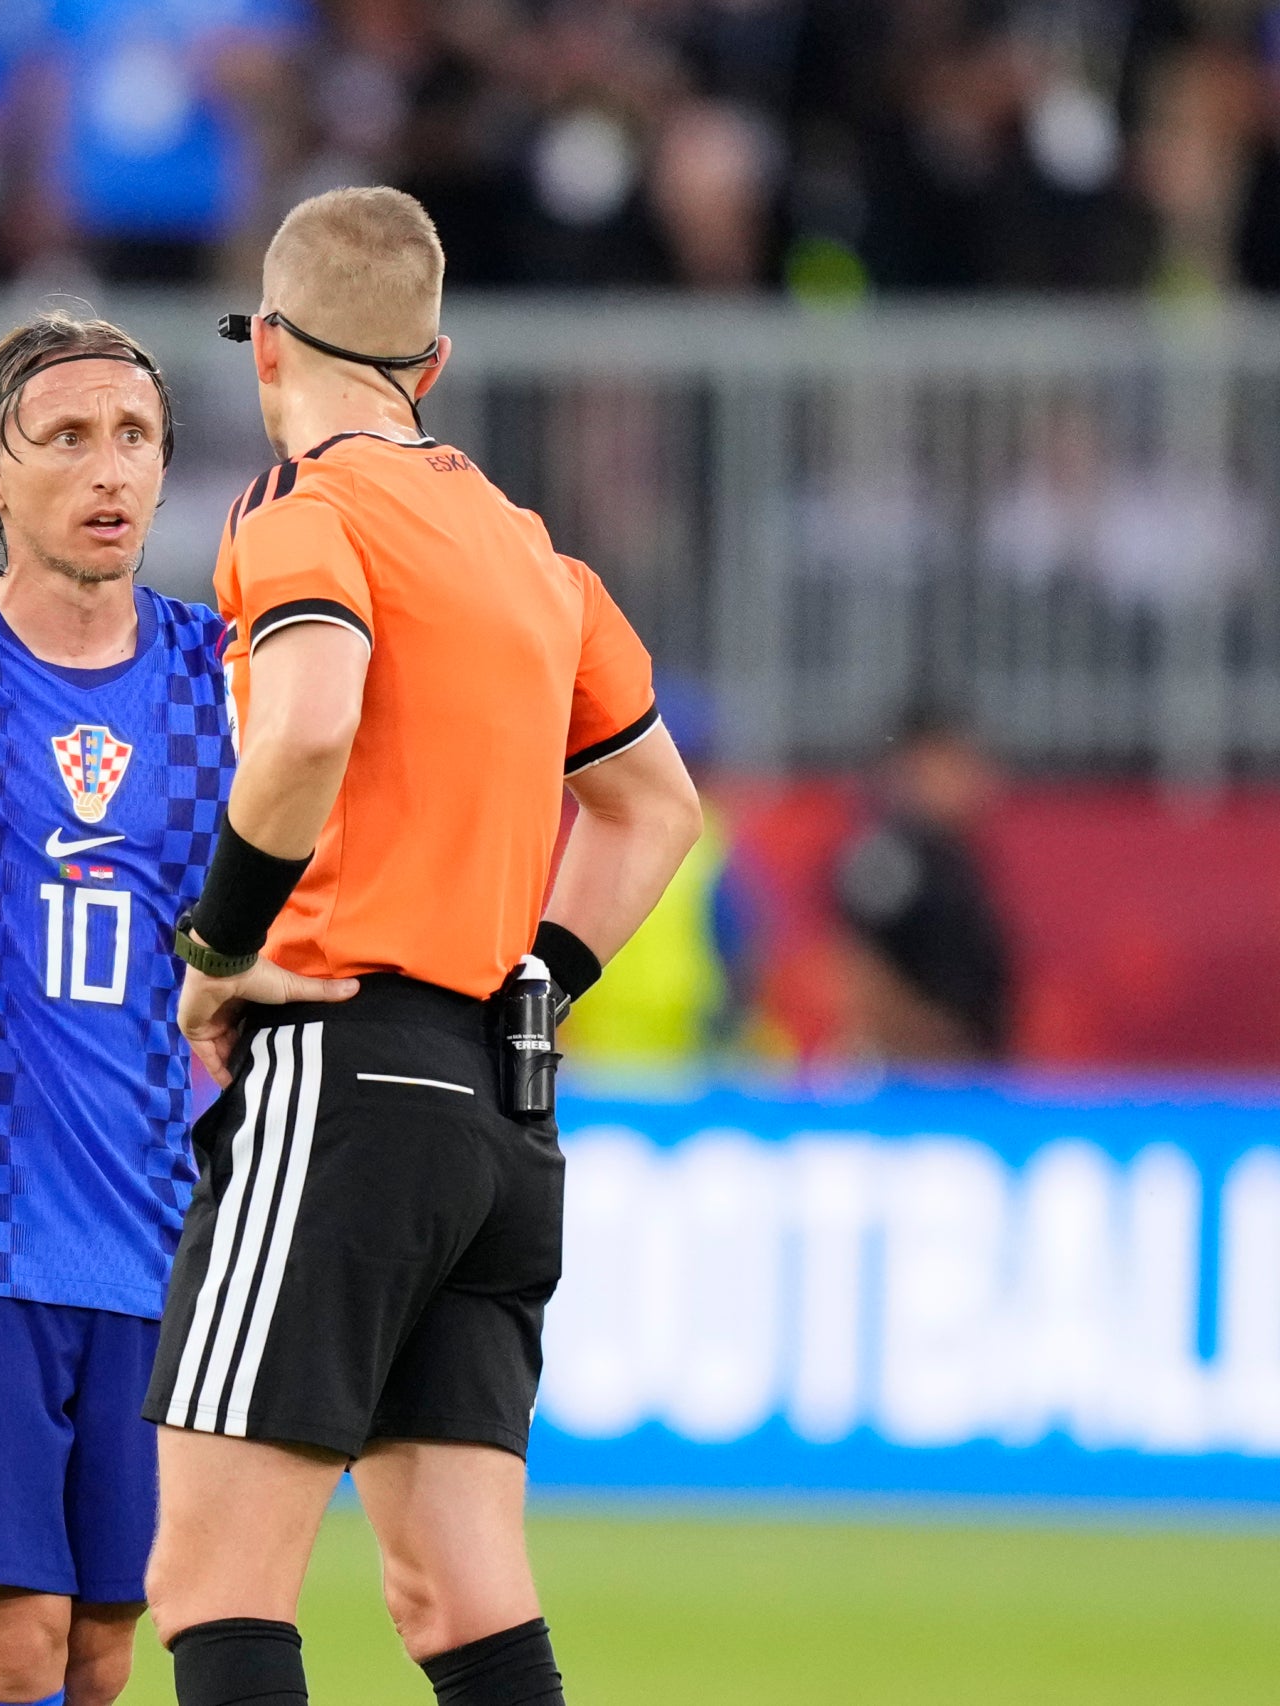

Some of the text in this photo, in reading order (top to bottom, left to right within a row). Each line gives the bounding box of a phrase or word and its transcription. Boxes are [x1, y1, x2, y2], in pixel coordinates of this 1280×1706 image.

[424, 453, 478, 473] ESKA
[40, 883, 131, 1005] 10
[511, 1041, 551, 1050] EREES
